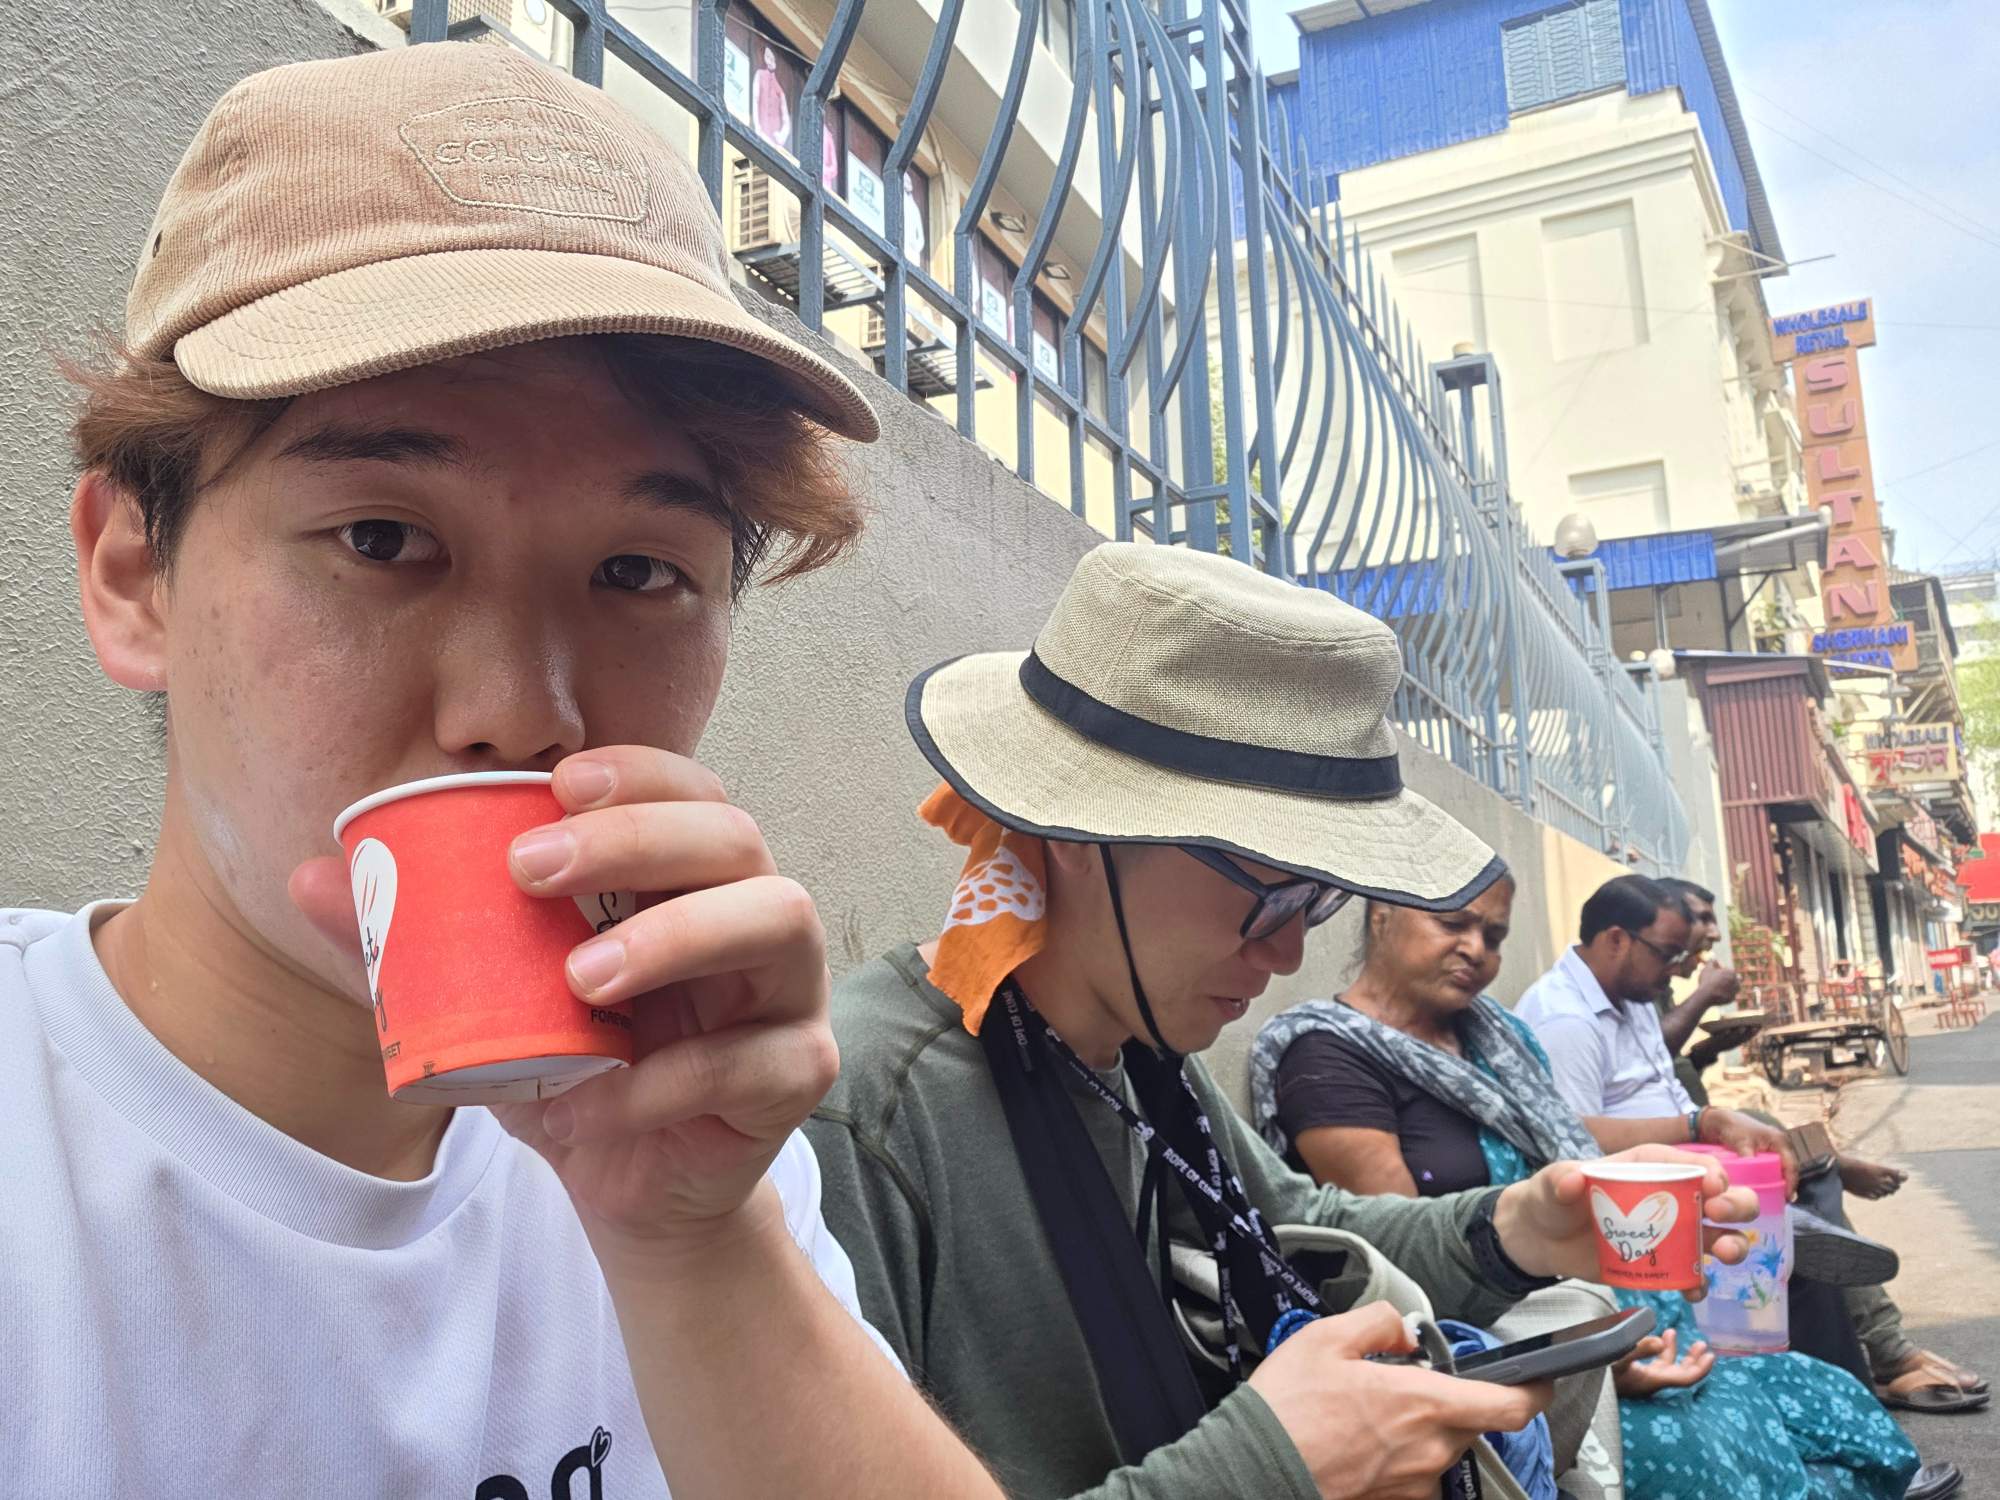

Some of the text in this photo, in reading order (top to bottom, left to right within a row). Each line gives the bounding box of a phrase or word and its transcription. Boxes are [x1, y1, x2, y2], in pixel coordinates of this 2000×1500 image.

[1772, 301, 1868, 336] WHOLESALE
[1795, 327, 1850, 356] RETAIL
[1804, 356, 1879, 622] SULTAN
[1162, 1147, 1190, 1174] ROPE
[1604, 1217, 1662, 1240] Sweet
[1618, 1241, 1656, 1266] Day
